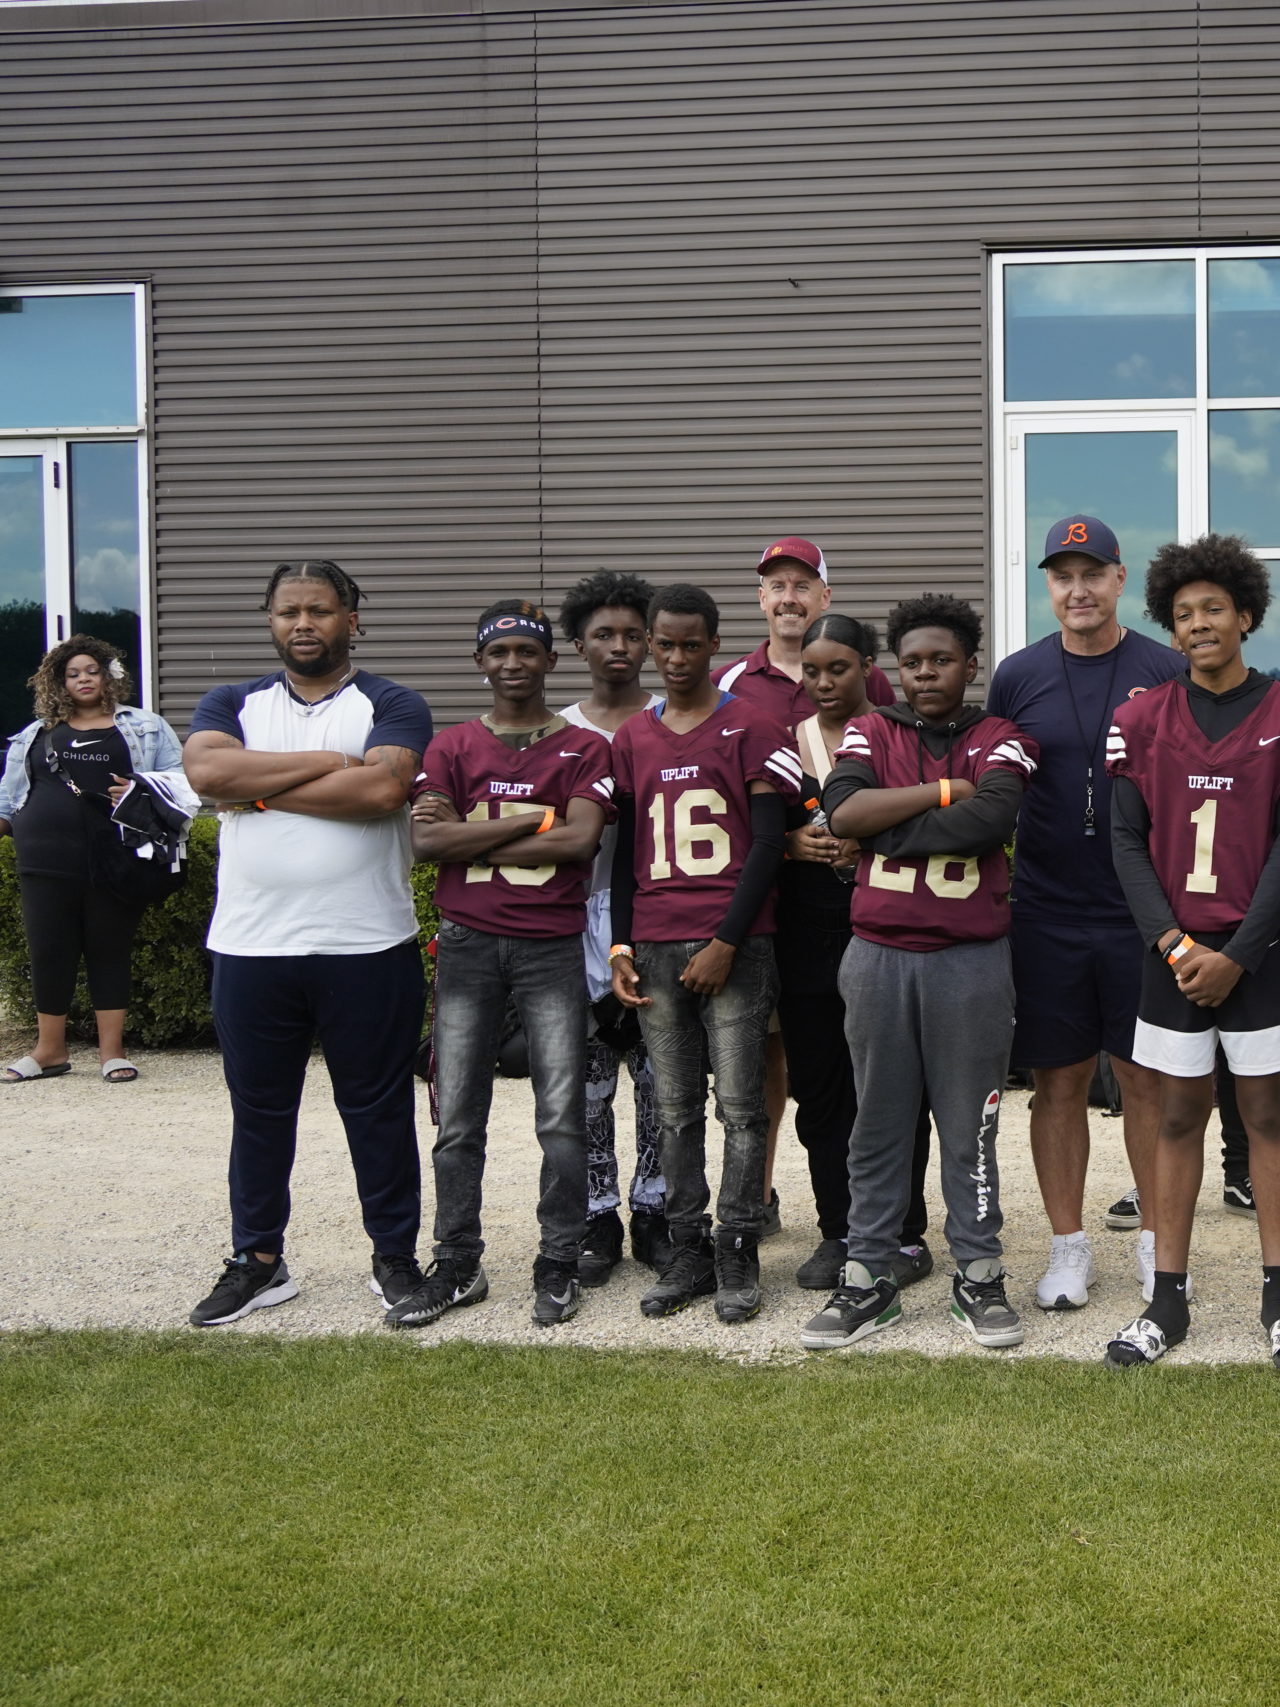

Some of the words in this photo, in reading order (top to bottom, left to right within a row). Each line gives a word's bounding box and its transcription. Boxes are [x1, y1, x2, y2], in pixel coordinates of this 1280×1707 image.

[62, 751, 110, 761] CHICAGO
[660, 765, 699, 781] UPLIFT
[490, 781, 534, 795] UPLIFT
[1188, 775, 1233, 790] UPLIFT
[648, 788, 732, 880] 16
[1185, 799, 1218, 894] 1
[969, 1088, 999, 1222] Champion
